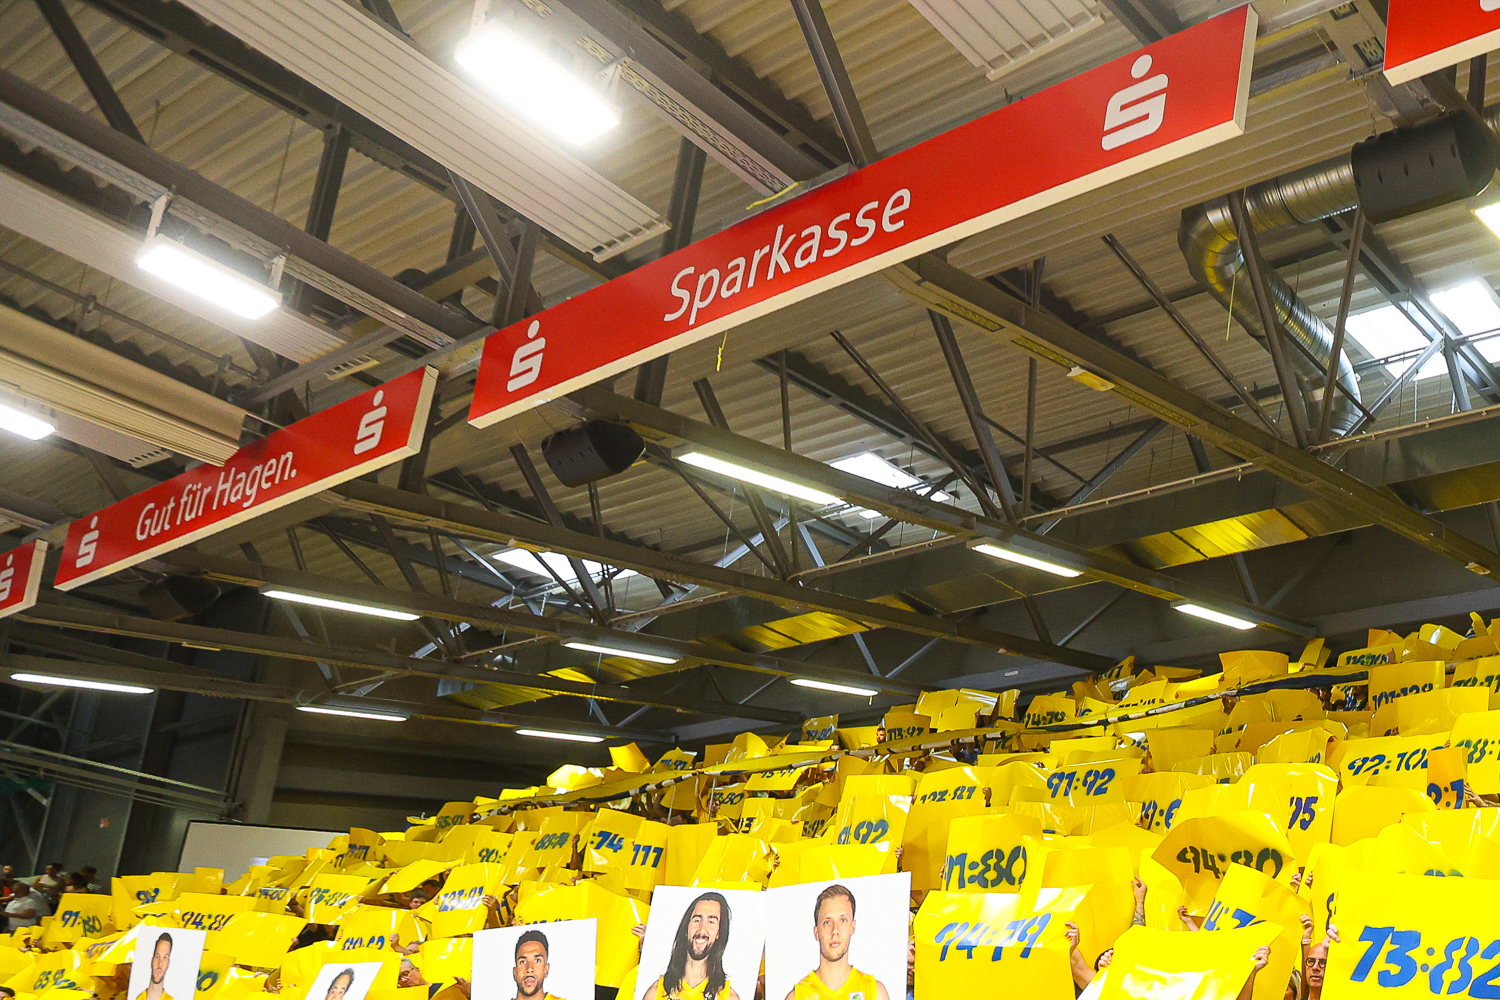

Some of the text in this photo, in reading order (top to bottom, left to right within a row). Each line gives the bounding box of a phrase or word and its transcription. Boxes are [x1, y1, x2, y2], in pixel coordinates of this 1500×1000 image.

[664, 187, 911, 323] Sparkasse
[136, 451, 297, 542] Gut für Hagen.
[1047, 768, 1115, 798] 91:92
[935, 912, 1052, 961] 94:79
